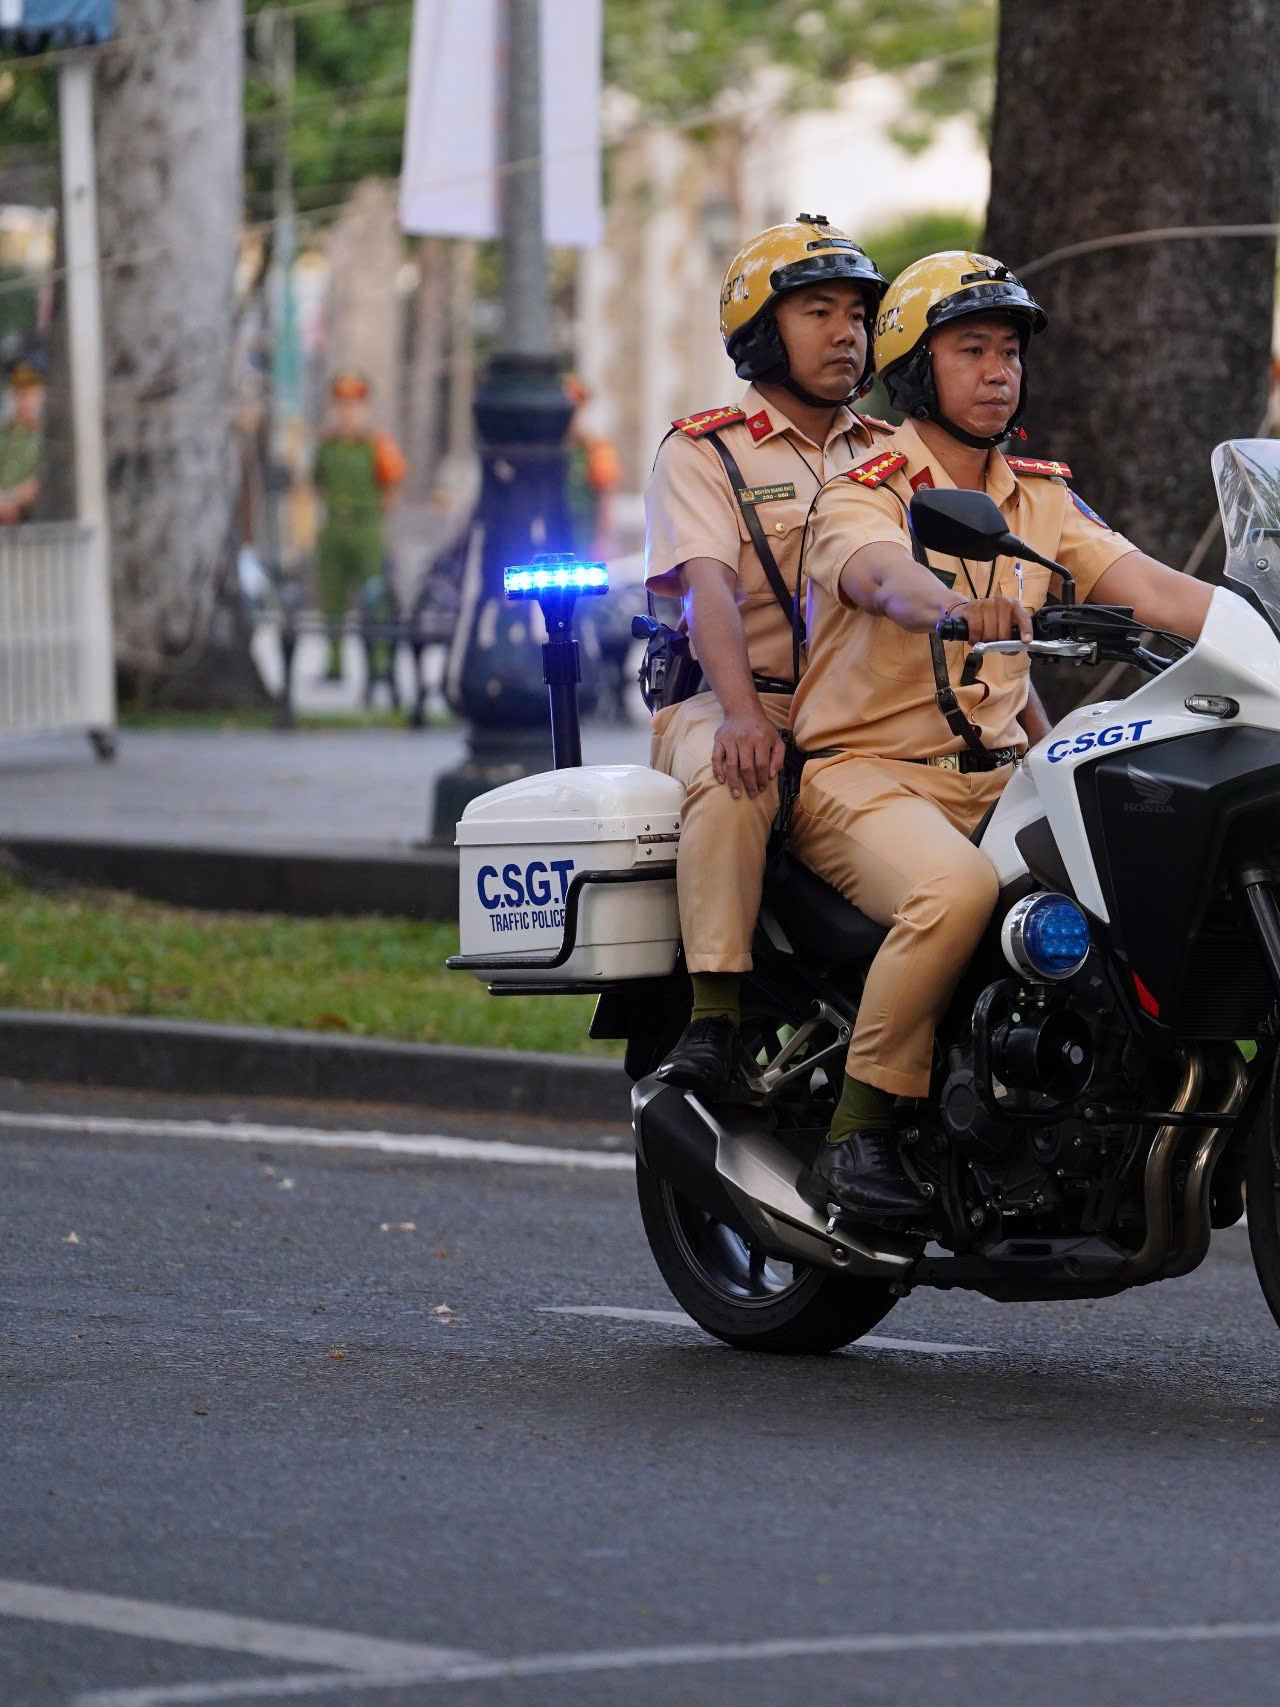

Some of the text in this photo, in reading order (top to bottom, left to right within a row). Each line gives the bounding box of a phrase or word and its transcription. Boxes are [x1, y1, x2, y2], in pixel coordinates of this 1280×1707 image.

[1123, 803, 1176, 814] HONDA
[490, 908, 566, 932] TRAFFIC POLICE
